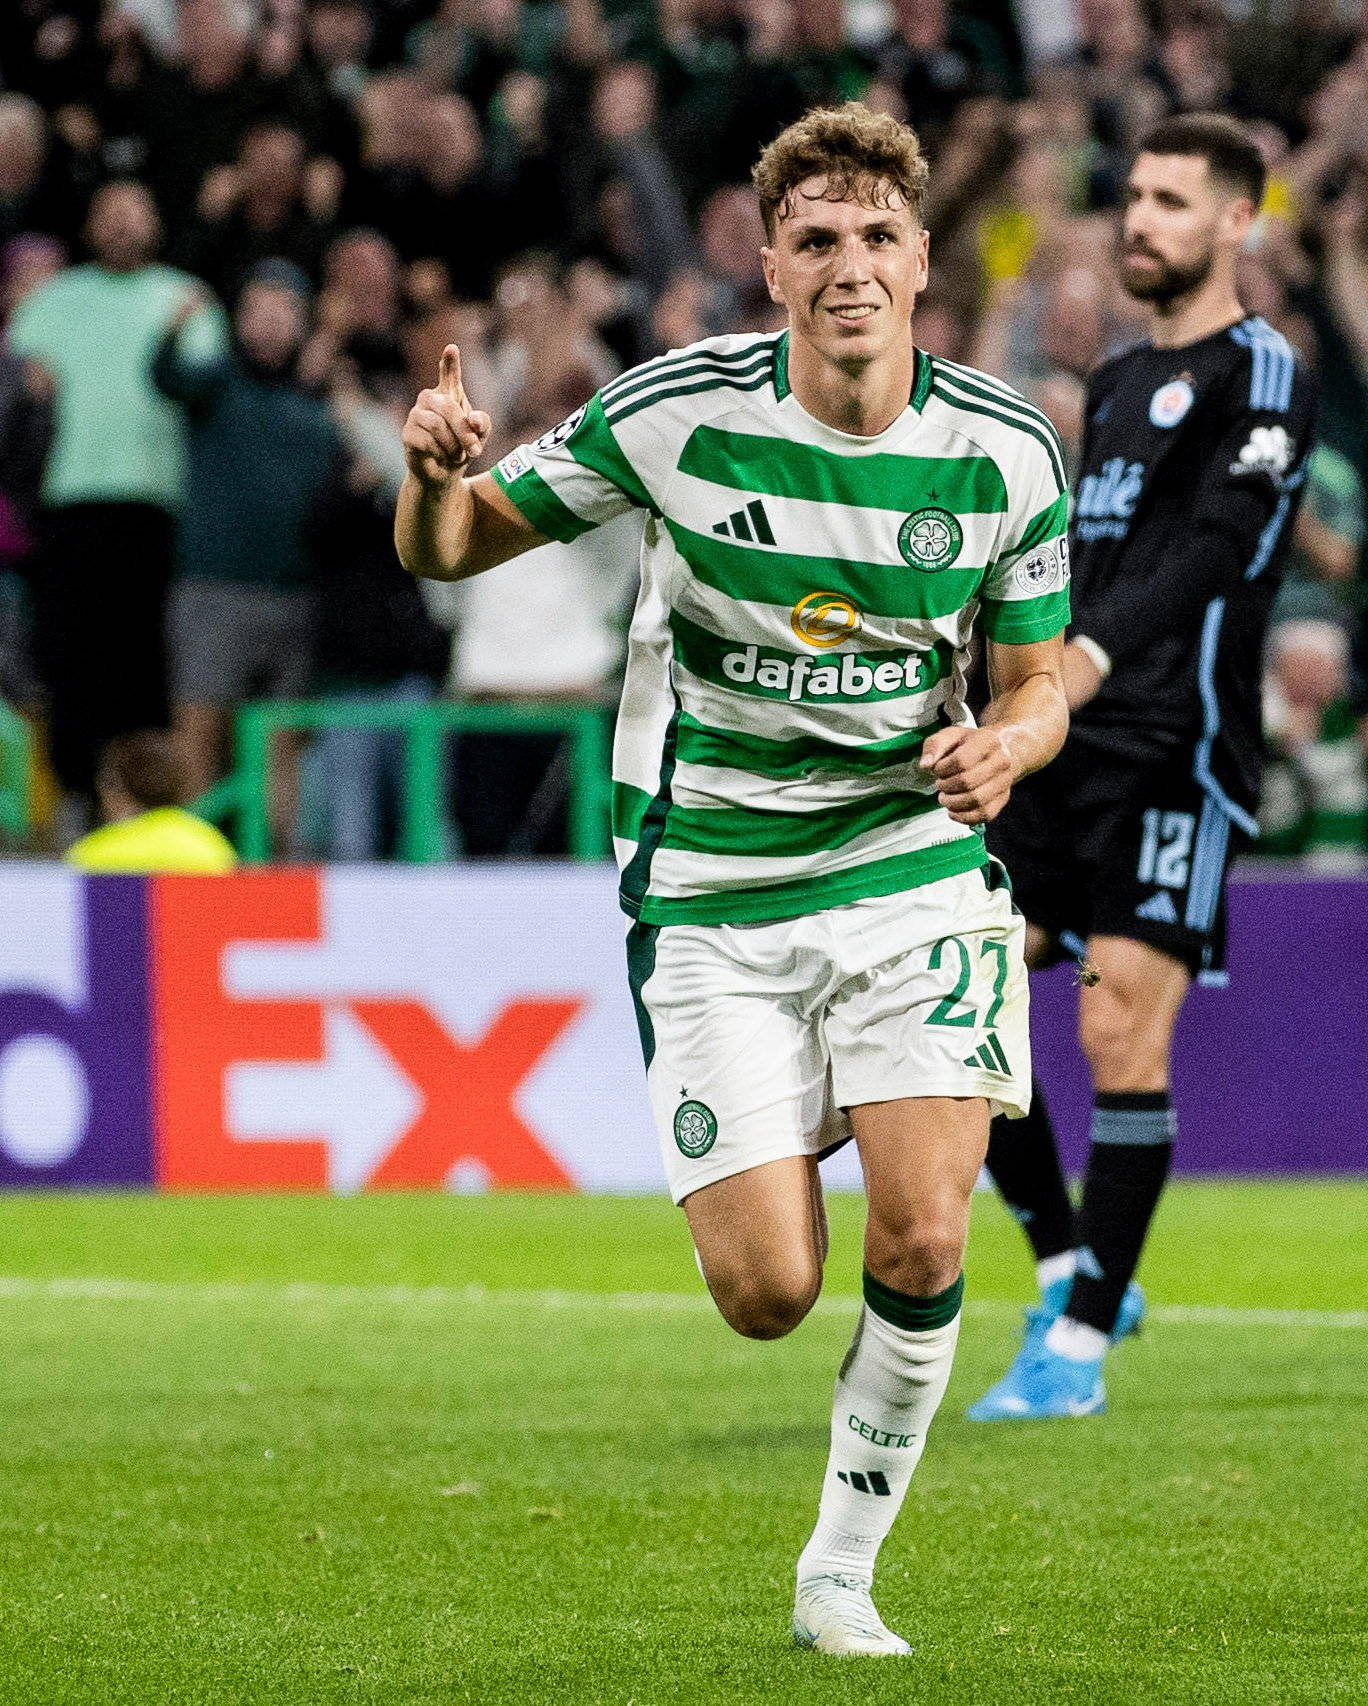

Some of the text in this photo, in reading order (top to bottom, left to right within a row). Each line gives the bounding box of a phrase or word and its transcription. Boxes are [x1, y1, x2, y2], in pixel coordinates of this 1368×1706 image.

[722, 645, 922, 701] dafabet
[1138, 808, 1195, 888] 12
[923, 935, 1007, 1029] 27
[848, 1414, 917, 1448] CELTIC
